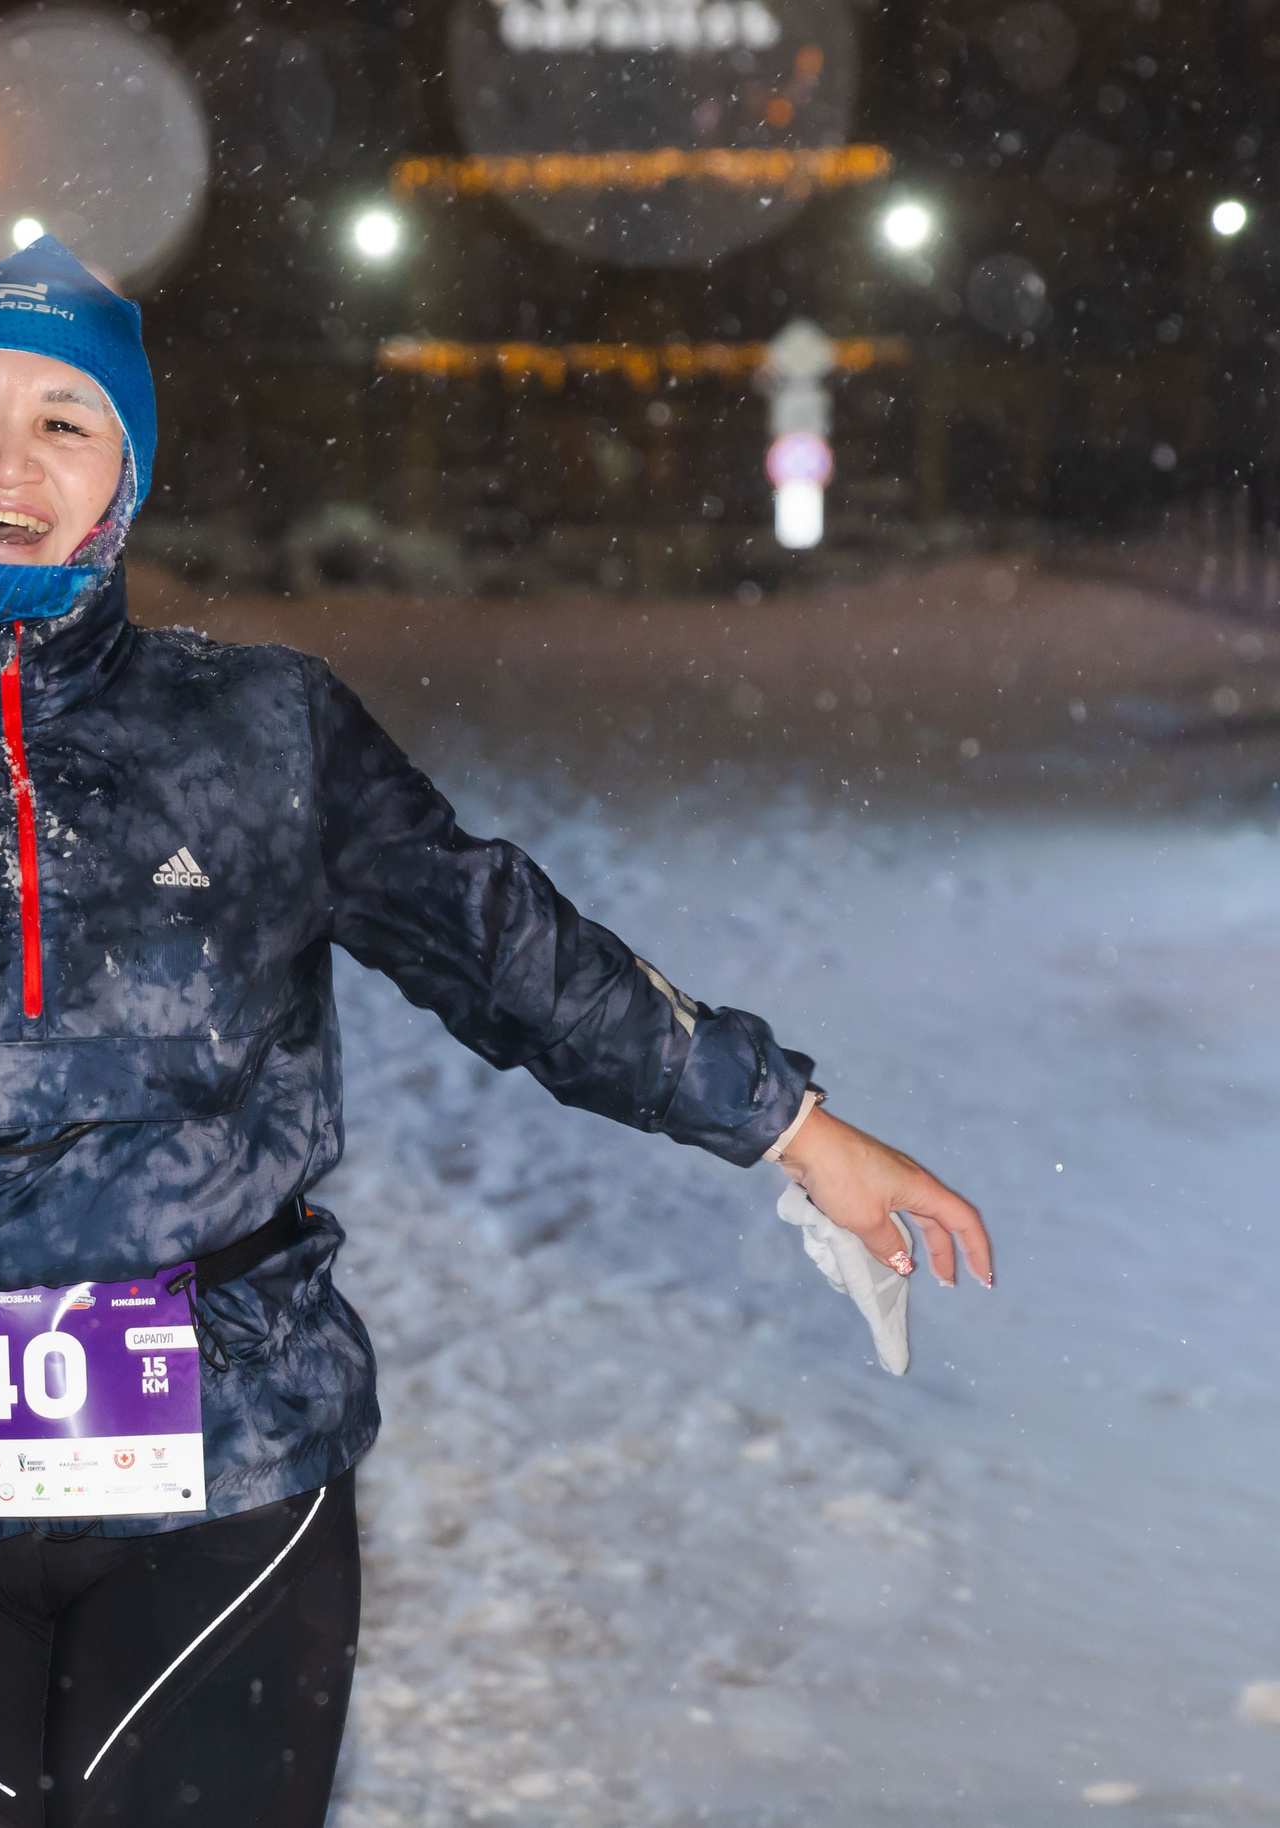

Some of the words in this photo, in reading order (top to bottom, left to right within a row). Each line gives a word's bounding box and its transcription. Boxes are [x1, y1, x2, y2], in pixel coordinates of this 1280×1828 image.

[152, 870, 211, 887] adidas
[133, 1333, 174, 1345] САРАПУЛ
[142, 1357, 168, 1377] 15
[142, 1378, 169, 1394] КМ
